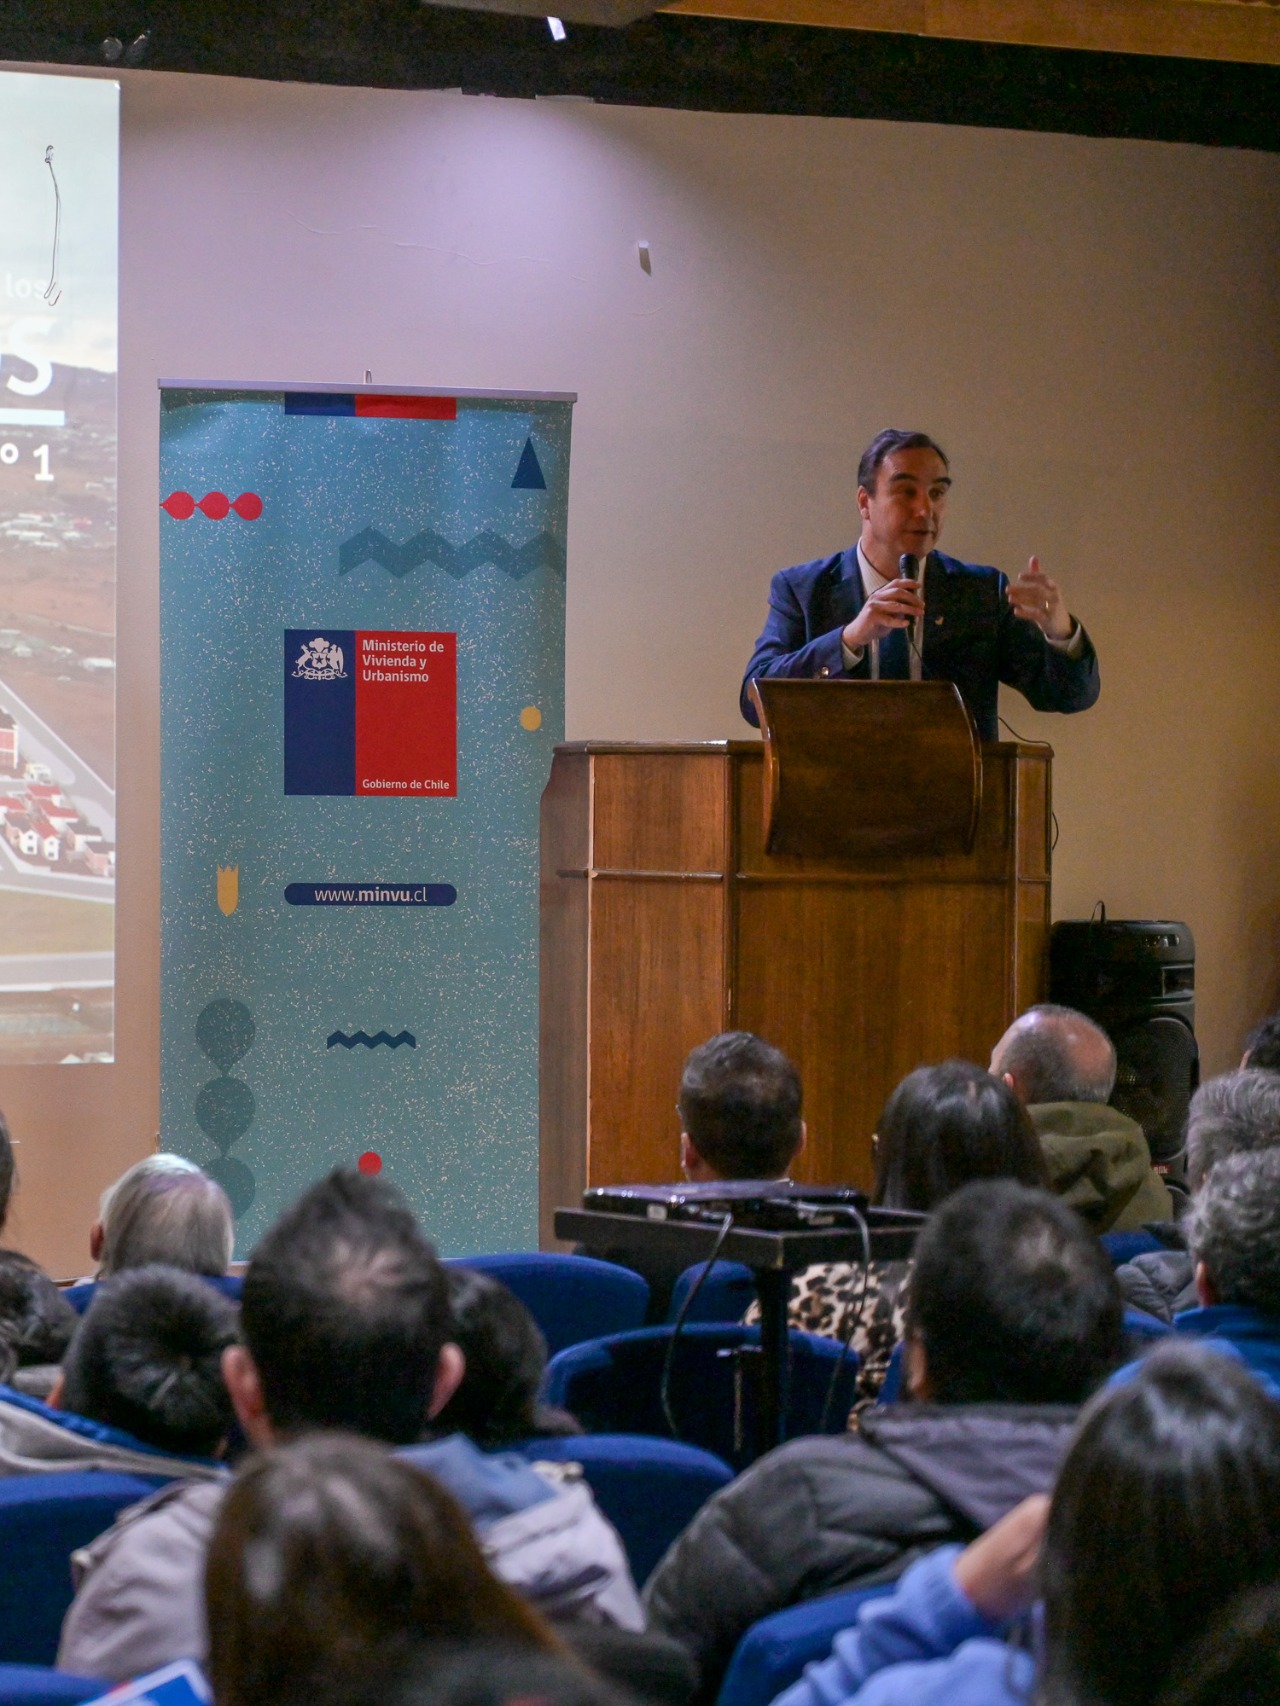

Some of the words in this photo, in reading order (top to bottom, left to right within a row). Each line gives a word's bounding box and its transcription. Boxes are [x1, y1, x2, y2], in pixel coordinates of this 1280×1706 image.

[5, 271, 48, 300] los
[34, 445, 55, 481] 1
[362, 639, 426, 653] Ministerio
[429, 640, 445, 653] de
[362, 654, 417, 667] Vivienda
[419, 658, 427, 670] y
[362, 670, 429, 683] Urbanismo
[362, 778, 408, 789] Gobierno
[410, 779, 422, 789] de
[424, 779, 450, 790] Chile
[314, 886, 428, 903] www.minvu.cl
